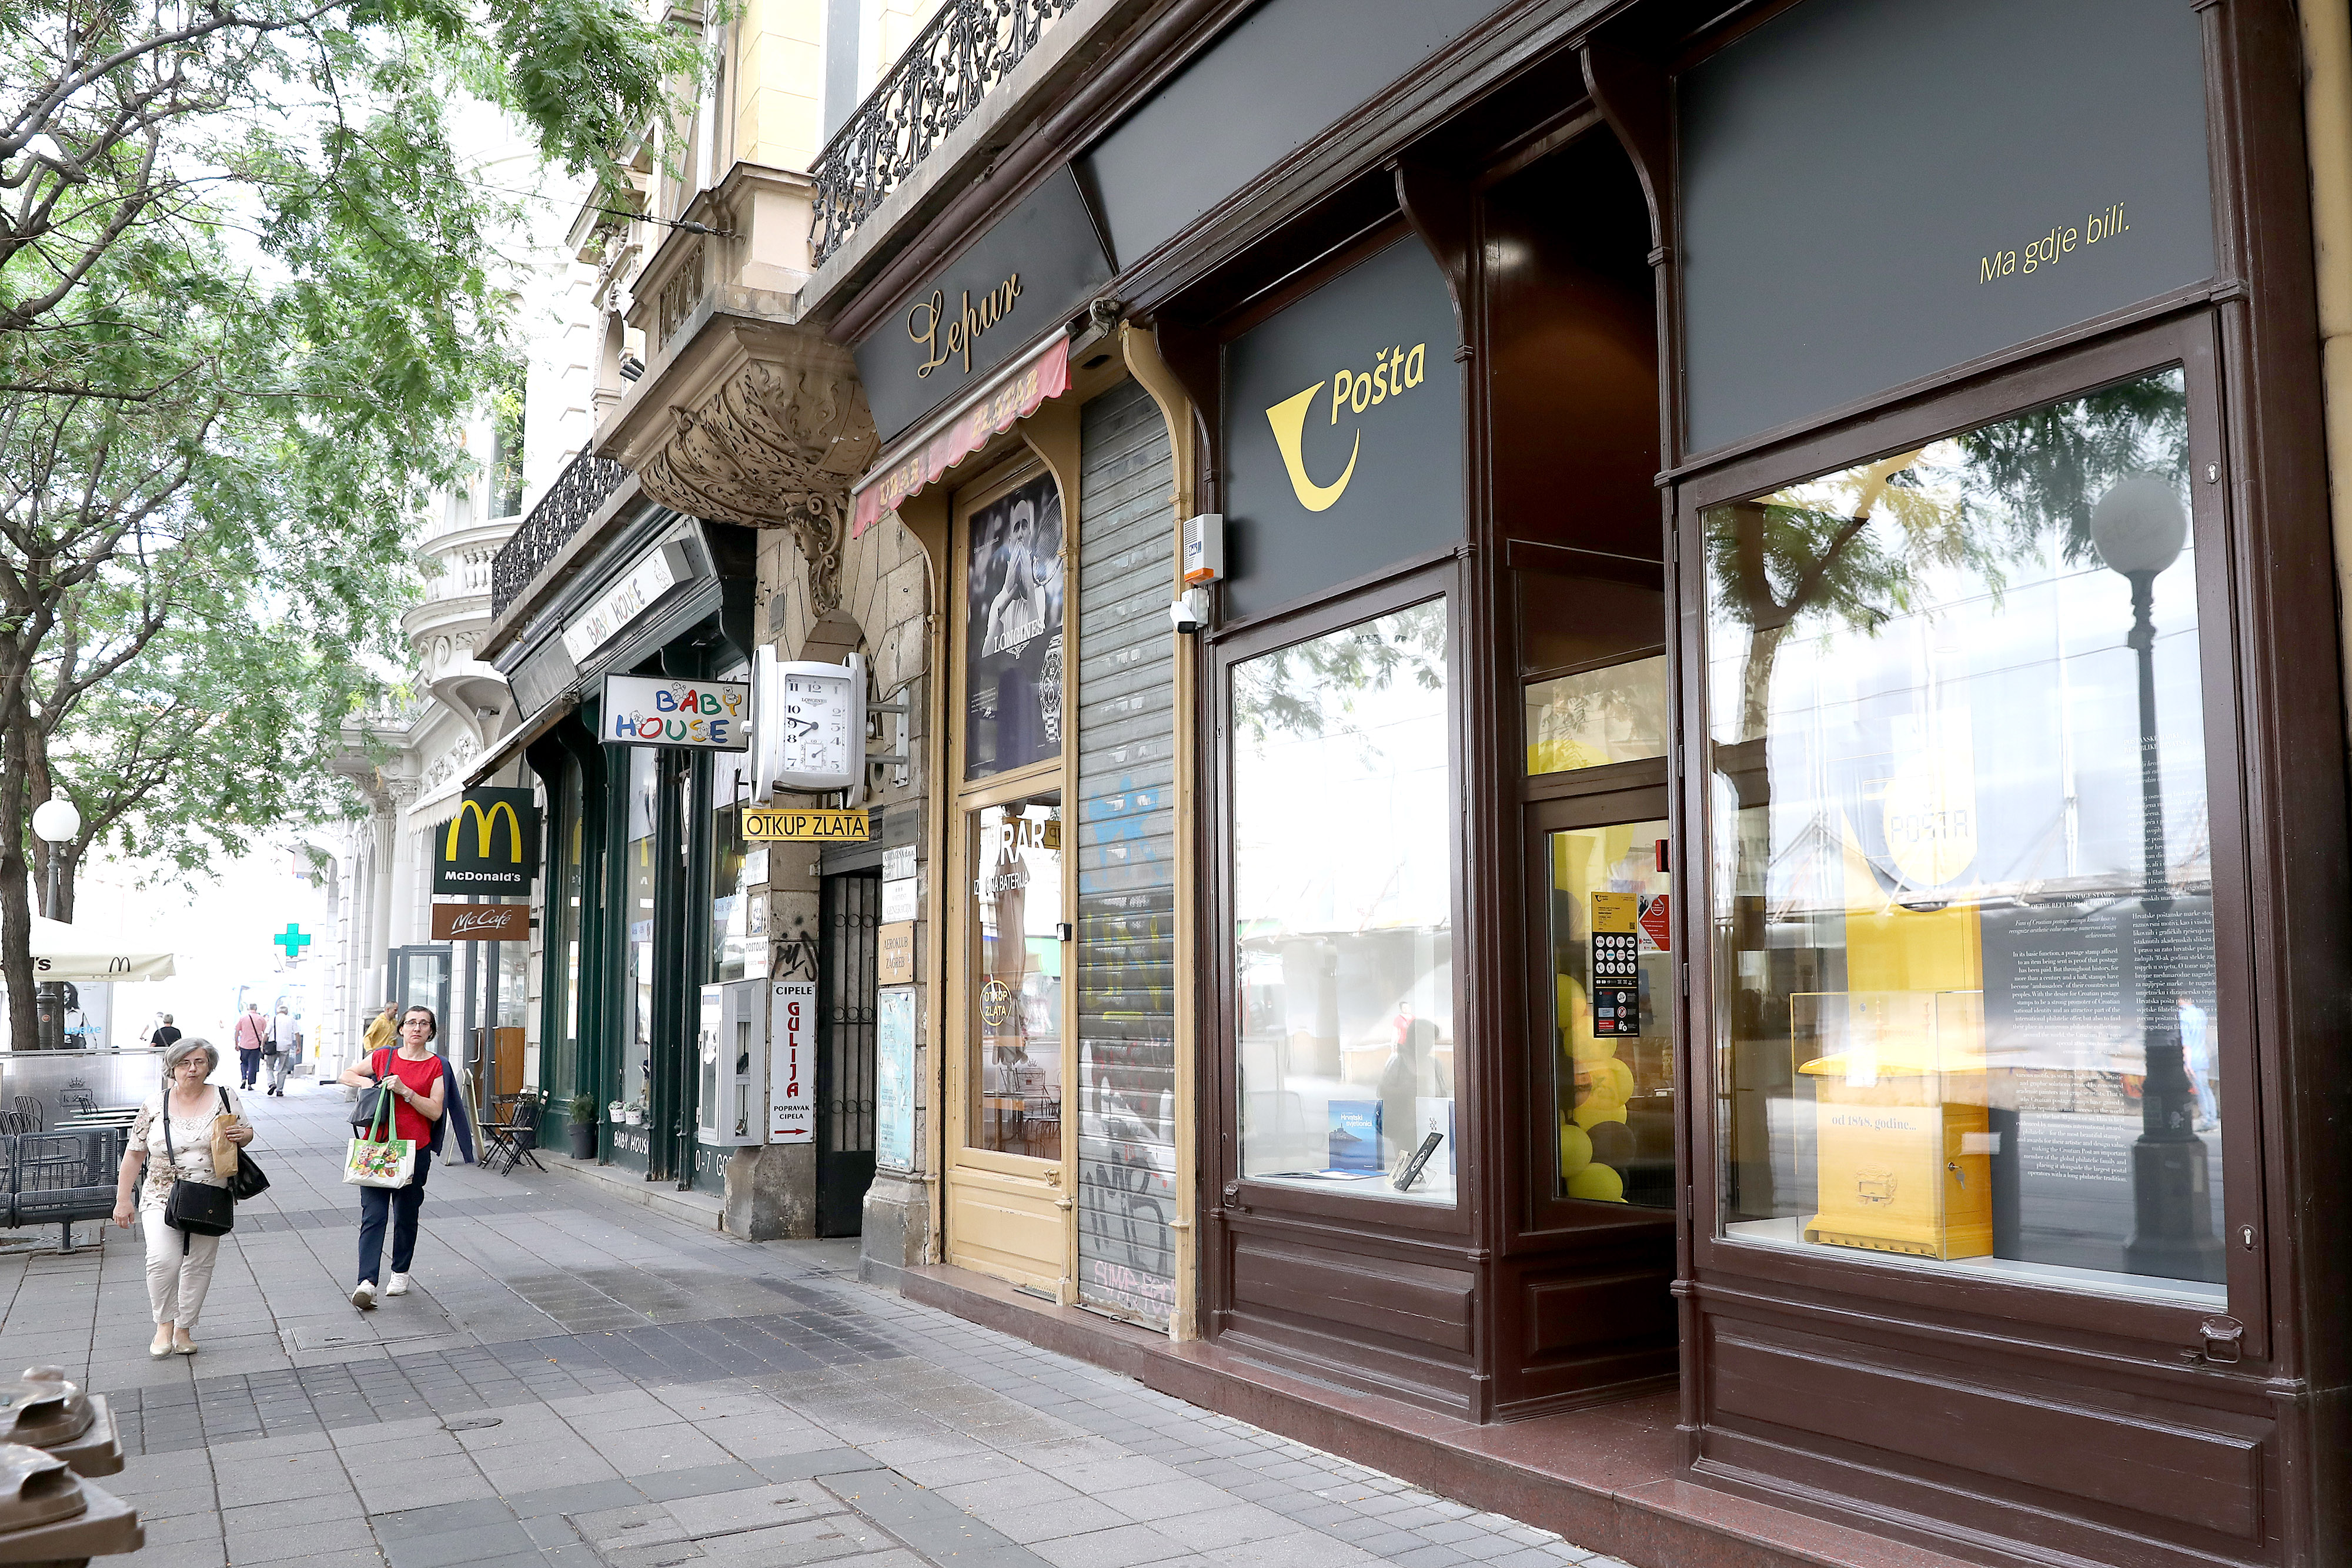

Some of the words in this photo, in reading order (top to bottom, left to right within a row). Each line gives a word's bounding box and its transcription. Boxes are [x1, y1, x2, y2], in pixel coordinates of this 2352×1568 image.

[1980, 250, 2016, 284] Ma
[2023, 226, 2077, 274] gdje
[2086, 202, 2130, 245] bili.
[1331, 343, 1425, 426] Pošta
[586, 608, 612, 647] BABY
[610, 578, 646, 624] HOUSE
[993, 618, 1045, 653] LONGINES
[790, 683, 799, 691] 11
[808, 684, 821, 693] 12
[834, 686, 838, 694] 1
[656, 688, 741, 718] BABY
[787, 705, 801, 714] 10
[832, 708, 841, 717] 2
[616, 714, 730, 744] HOUSE
[787, 720, 797, 728] 9
[787, 734, 797, 743] 8
[830, 737, 841, 745] 4
[787, 758, 797, 767] 7
[831, 761, 840, 769] 5
[746, 815, 806, 837] OTKUP
[812, 815, 866, 836] ZLATA
[445, 871, 522, 882] McDonald's
[1000, 870, 1028, 892] BATERIJA
[451, 909, 512, 932] McCafé
[884, 936, 908, 950] AEROKLUB
[886, 957, 905, 969] ZAGREB
[776, 985, 812, 995] CIPELE
[984, 990, 1008, 1003] OTKUP
[985, 1005, 1007, 1017] ZLATA
[1832, 1115, 1845, 1125] od
[1848, 1115, 1872, 1127] 1848.
[1875, 1118, 1916, 1131] godine...
[613, 1130, 629, 1149] BABY
